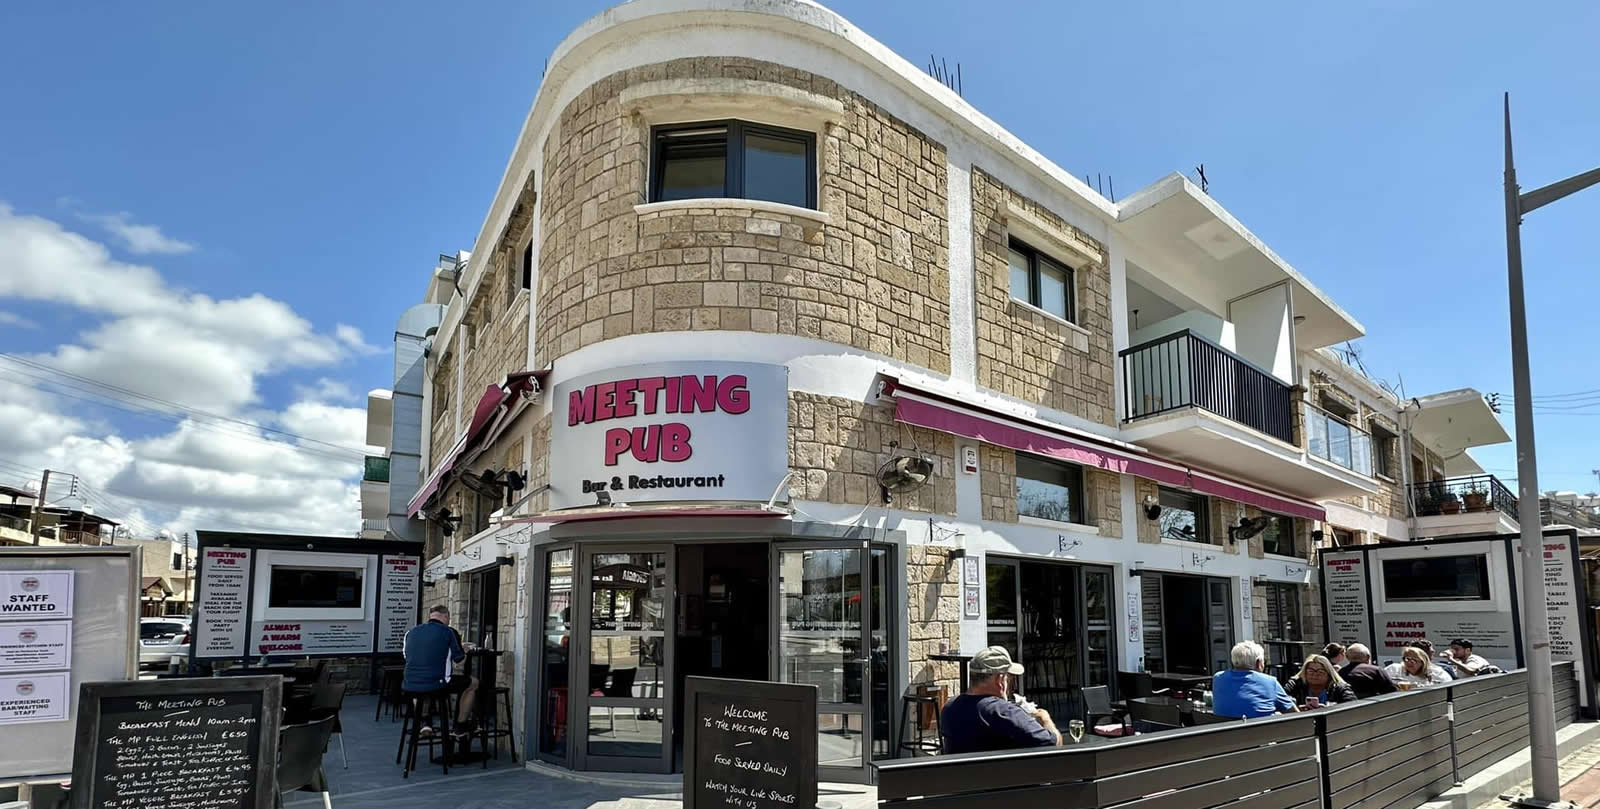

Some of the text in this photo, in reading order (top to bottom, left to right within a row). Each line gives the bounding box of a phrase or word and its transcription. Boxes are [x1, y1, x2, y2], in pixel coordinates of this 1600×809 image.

[568, 374, 750, 427] MEETING
[604, 422, 693, 466] PUB
[582, 474, 725, 493] Bar & Restaurant
[9, 594, 49, 603] STAFF
[2, 603, 56, 612] WANTED
[271, 633, 301, 641] WARM
[258, 643, 303, 652] WELCOME
[0, 698, 51, 706] EXPERIENCED
[158, 699, 203, 709] MEETING
[207, 697, 226, 707] PUB
[724, 704, 768, 722] WELCOME
[118, 719, 171, 730] BREAKFAST
[715, 719, 730, 731] THE
[731, 722, 768, 736] MEETING
[772, 727, 790, 740] PUB
[734, 757, 761, 771] SERVED
[763, 762, 787, 777] DAILY
[705, 779, 796, 804] WATCH YOUR LIVE SPORTS
[746, 800, 757, 809] US
